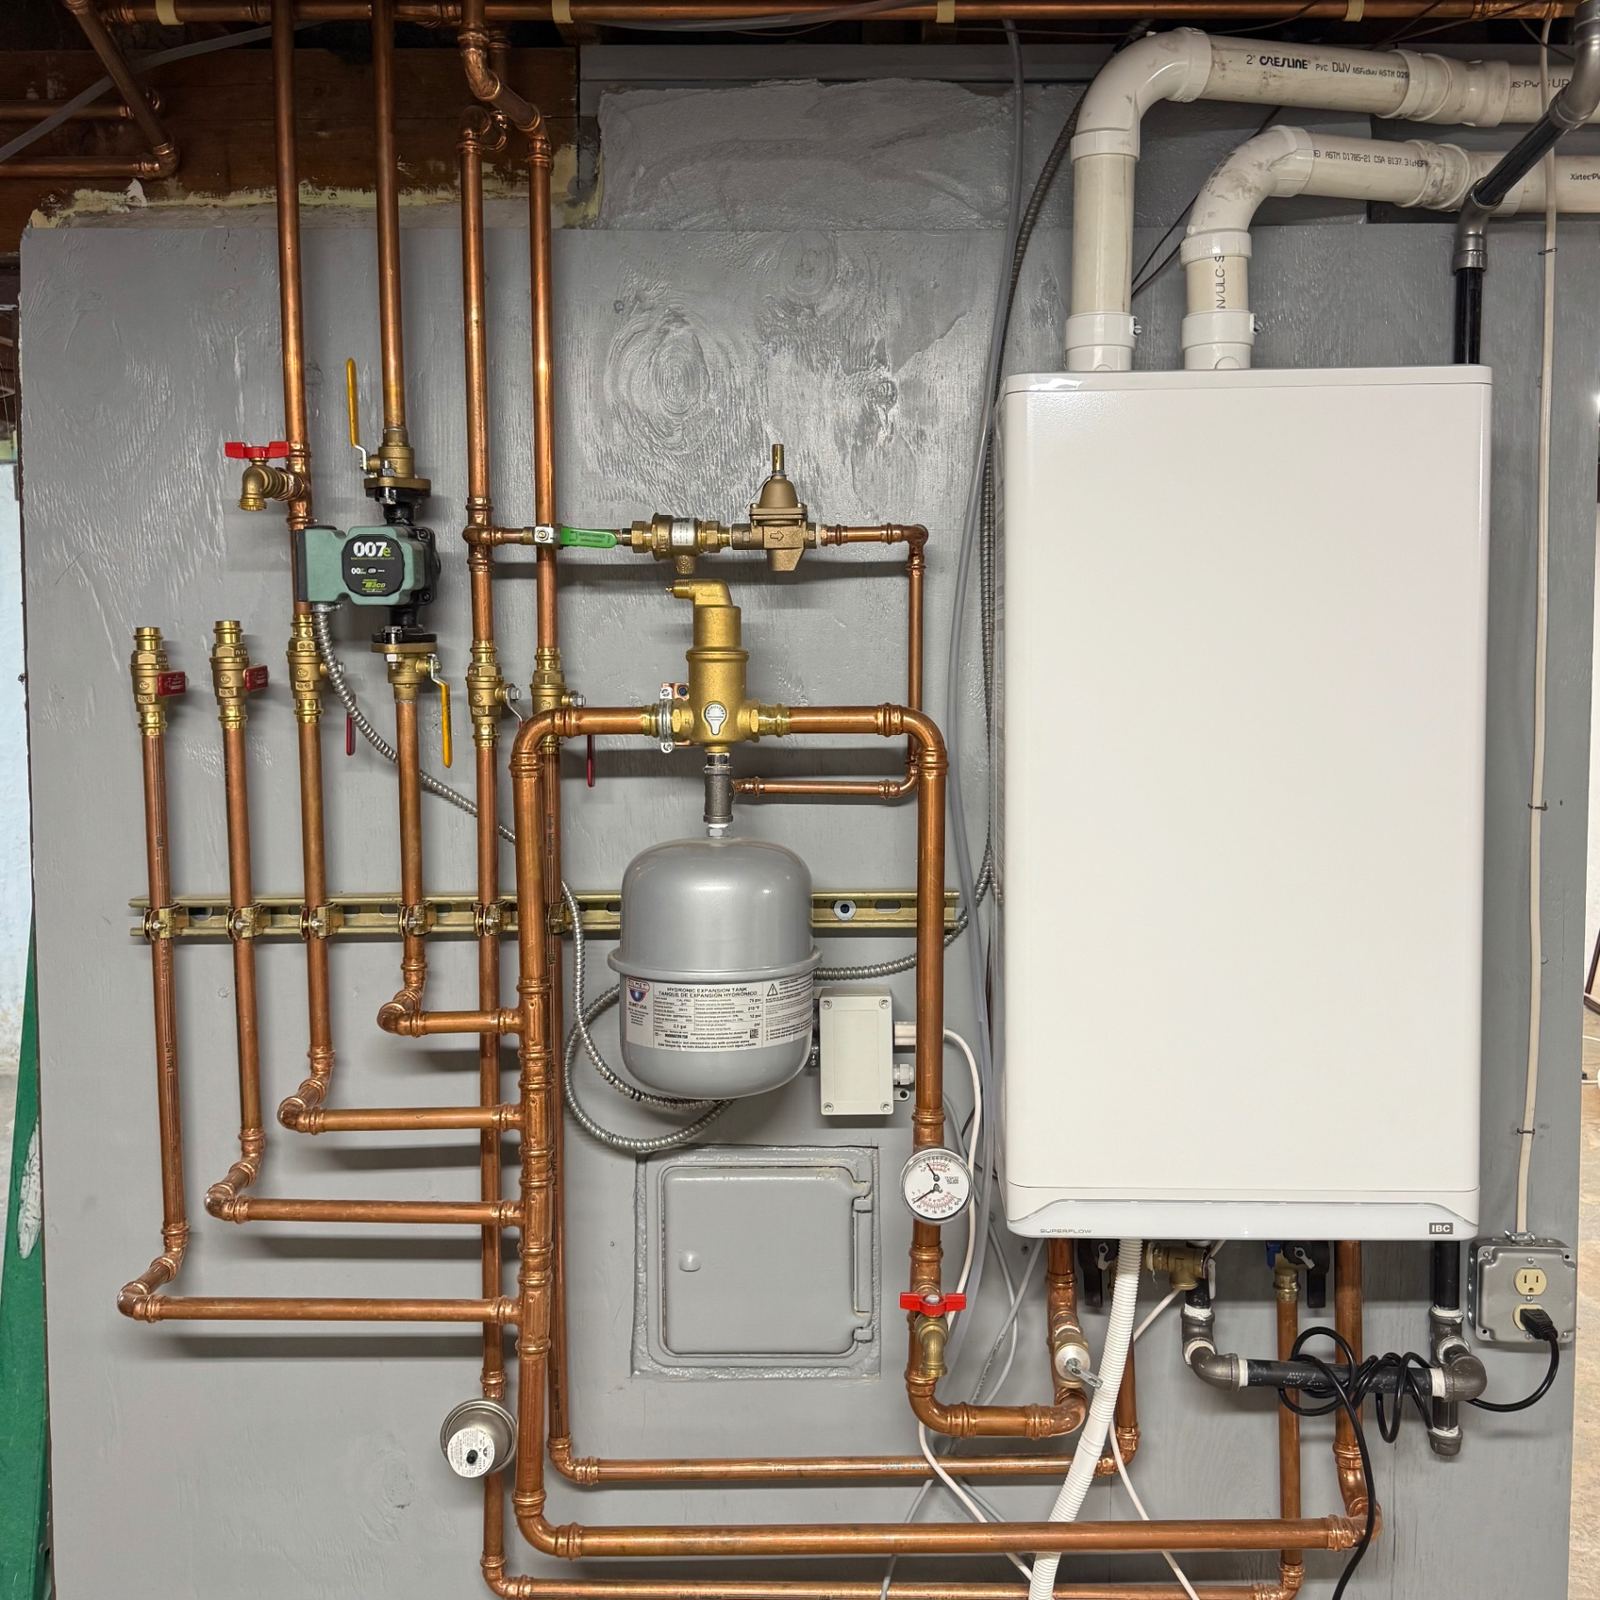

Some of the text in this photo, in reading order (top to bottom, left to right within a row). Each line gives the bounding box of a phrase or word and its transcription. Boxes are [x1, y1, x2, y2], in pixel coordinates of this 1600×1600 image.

[1259, 55, 1309, 70] CRESLINE
[1315, 63, 1329, 72] PVC
[1332, 61, 1351, 74] DWV
[1325, 151, 1341, 160] ASTM
[1431, 1224, 1451, 1233] IBC
